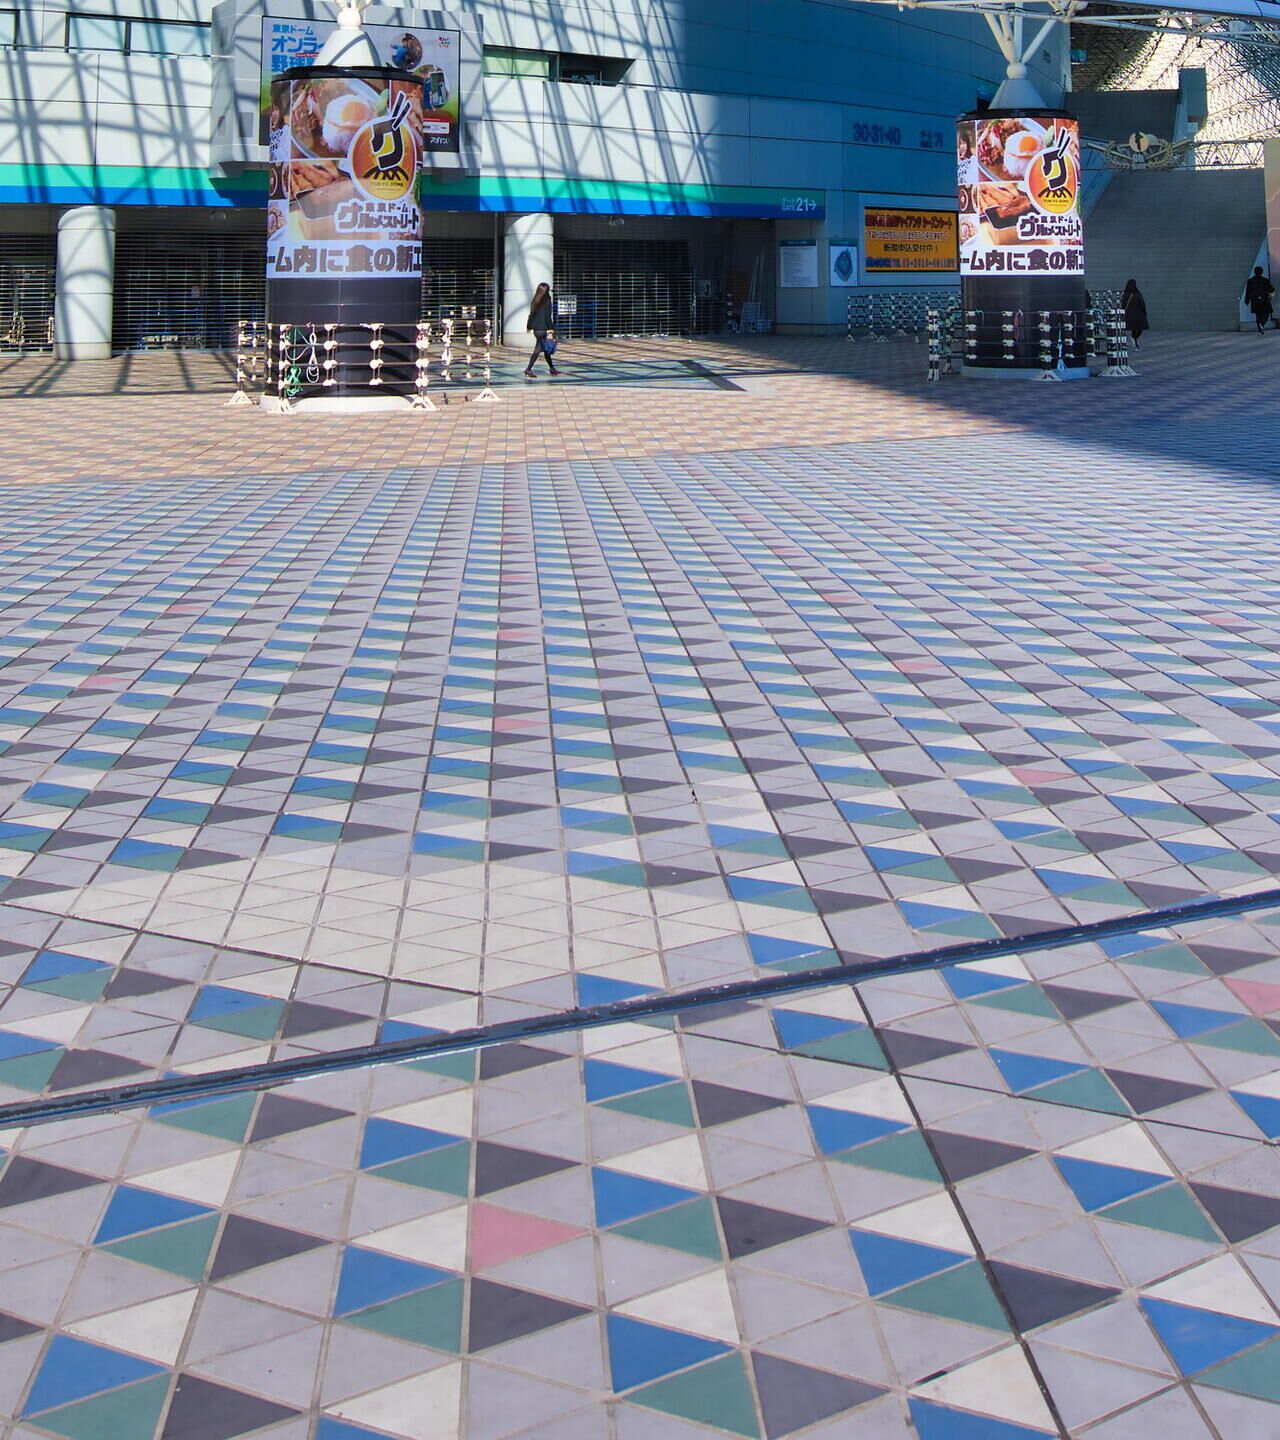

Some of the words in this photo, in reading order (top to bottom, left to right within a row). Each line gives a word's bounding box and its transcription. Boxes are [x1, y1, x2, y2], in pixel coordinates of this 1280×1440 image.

[272, 24, 314, 35] 東京ドーム
[366, 203, 408, 212] 東京ドーム
[796, 197, 808, 212] 21
